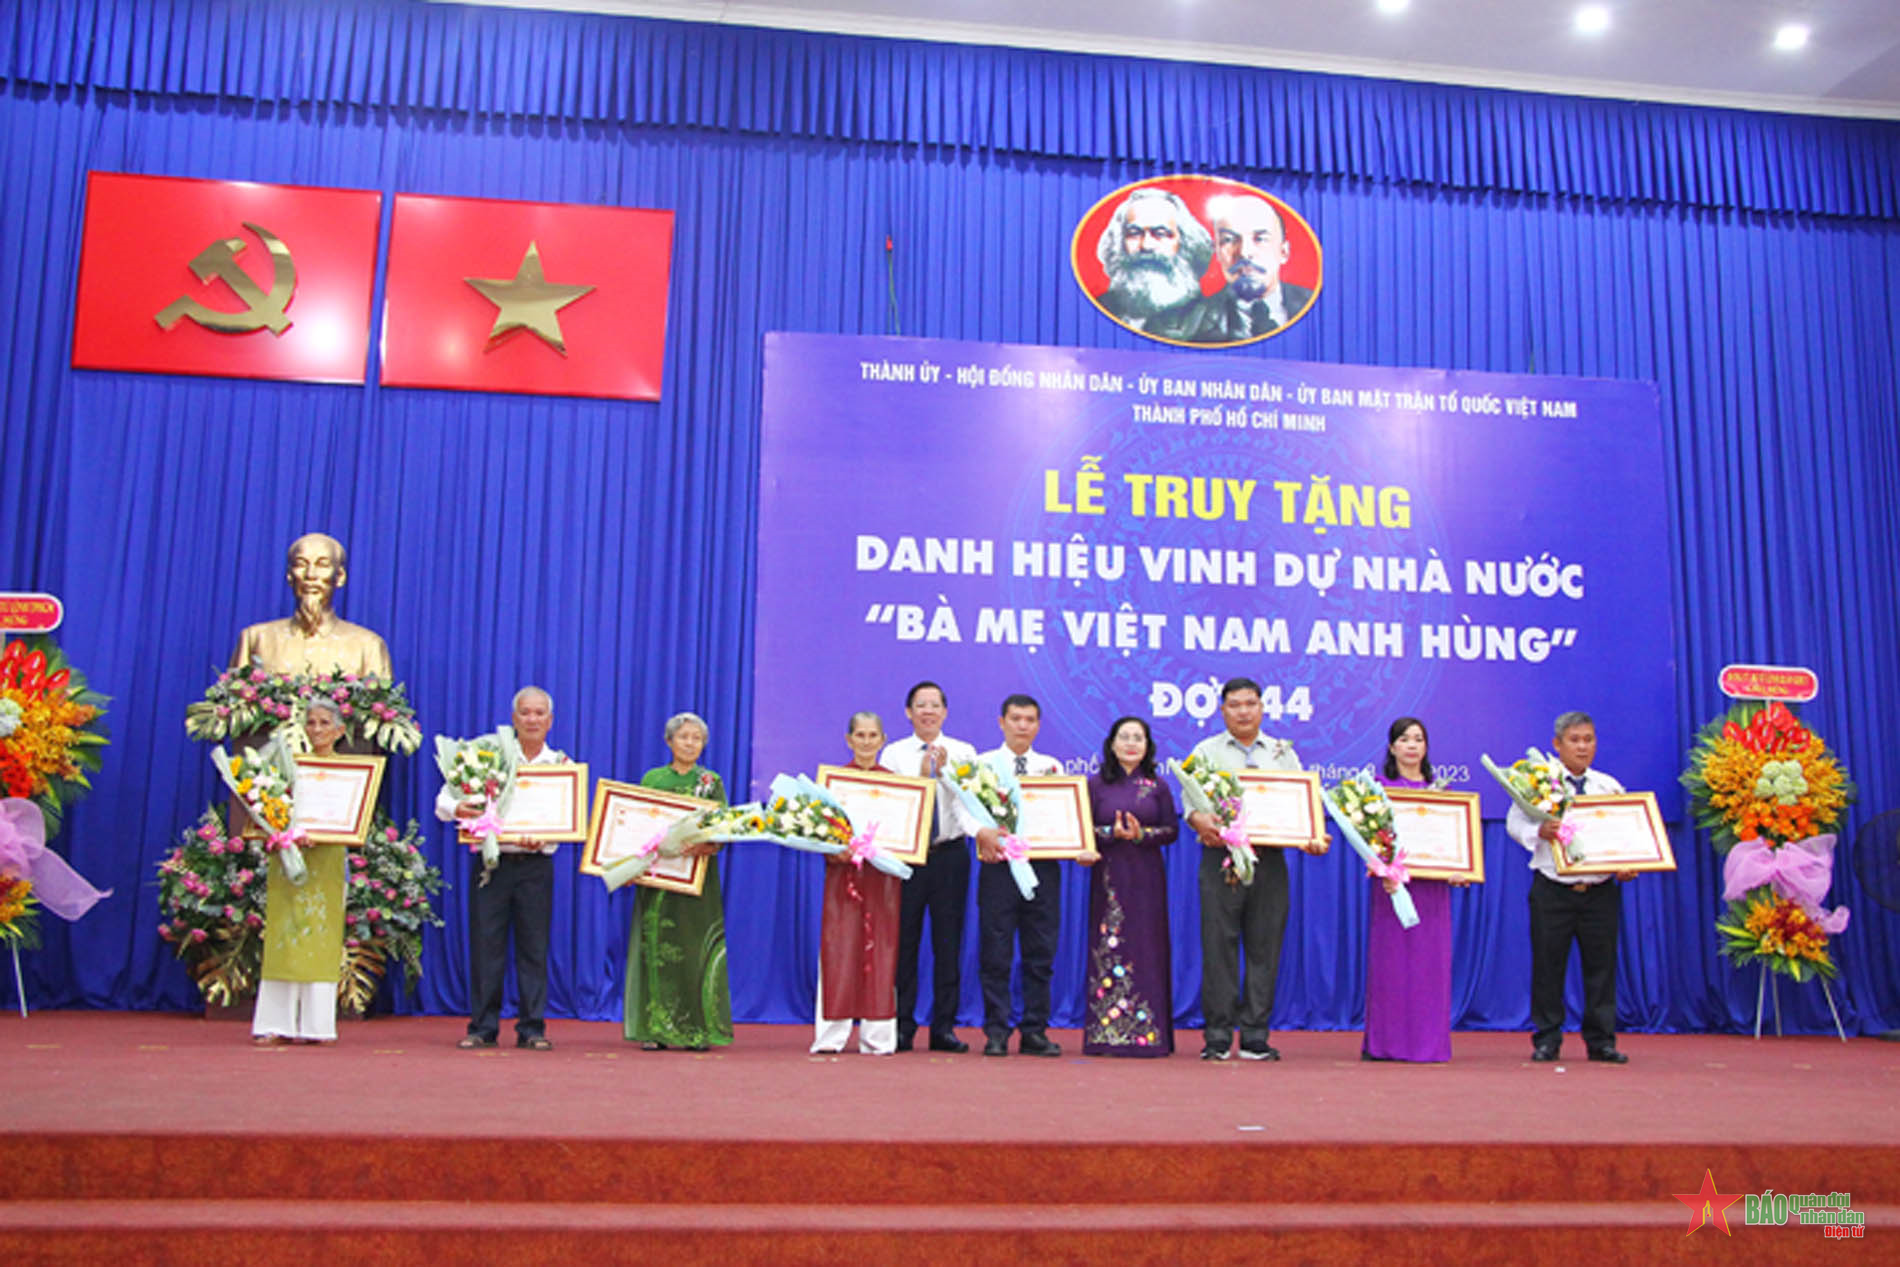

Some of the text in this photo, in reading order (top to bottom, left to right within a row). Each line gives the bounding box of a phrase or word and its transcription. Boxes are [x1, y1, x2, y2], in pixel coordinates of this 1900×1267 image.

[860, 360, 915, 383] THÀNH
[919, 360, 941, 383] ỦY
[957, 364, 986, 389] HỘI
[1039, 369, 1085, 392] NHÂN
[1089, 371, 1123, 393] DÂN
[1138, 372, 1159, 396] ỦY
[1163, 378, 1197, 397] BAN
[1201, 379, 1245, 400] NHÂN
[1249, 381, 1282, 402] DÂN
[1297, 382, 1317, 405] ỦY
[1321, 387, 1352, 407] BAN
[1461, 392, 1501, 415] QUỐC
[1504, 396, 1537, 420] VIỆT
[1542, 400, 1578, 419] NAM
[1132, 401, 1185, 424] THÀNH
[1190, 403, 1223, 427] PHỐ
[1252, 408, 1278, 430] CHÍ
[1282, 412, 1326, 432] MINH
[1044, 454, 1412, 534] LỄ TRUY TẶNG
[855, 532, 1585, 600] DANH HIỆU VINH DỰ NHÀ NƯỚC
[975, 607, 1045, 655] MẸ
[1062, 602, 1167, 658] VIỆT
[1183, 615, 1292, 653] NAM
[1305, 619, 1404, 658] ANH
[1148, 676, 1314, 728] ĐỢ 44
